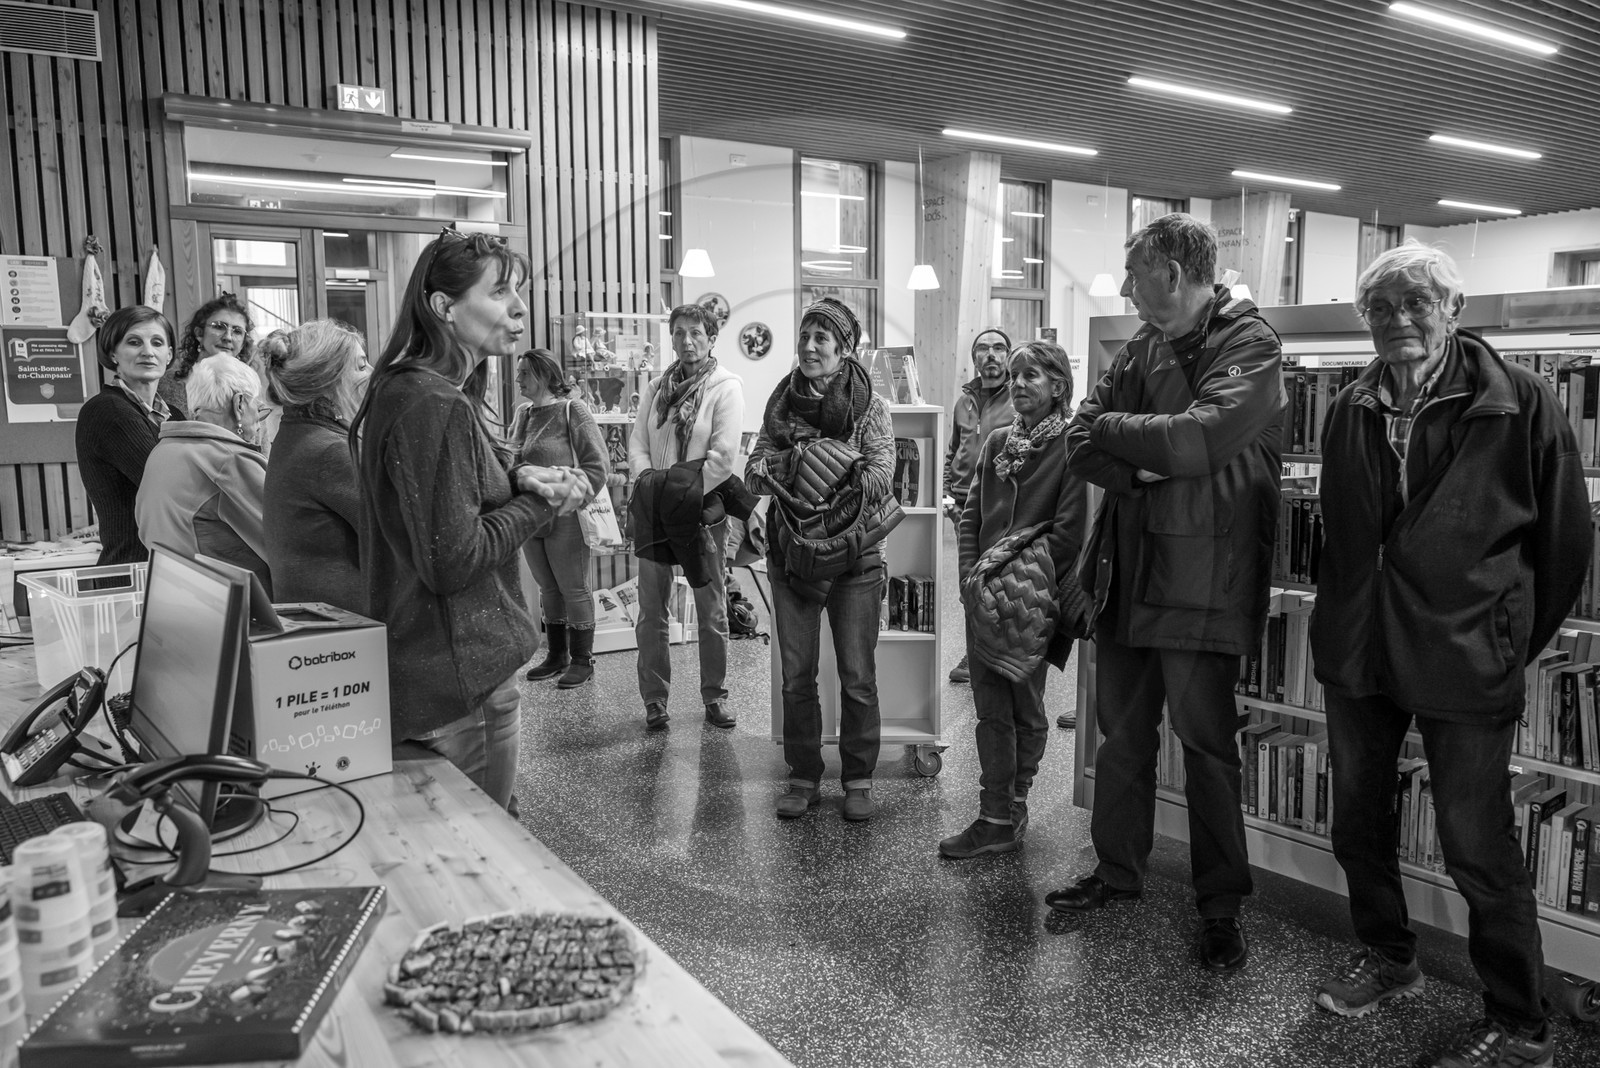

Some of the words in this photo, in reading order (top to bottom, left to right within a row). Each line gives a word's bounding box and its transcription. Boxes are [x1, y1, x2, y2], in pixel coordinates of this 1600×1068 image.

[17, 372, 73, 380] en-Champsaur
[896, 447, 919, 461] KING
[304, 650, 356, 667] batribox
[275, 696, 283, 709] 1
[287, 690, 318, 707] PILE
[321, 691, 329, 699] =
[332, 687, 339, 698] 1
[343, 681, 371, 697] DON
[294, 709, 310, 718] pour
[312, 706, 319, 714] le
[320, 701, 351, 712] Téléthon
[149, 903, 271, 1013] CHEVERNY
